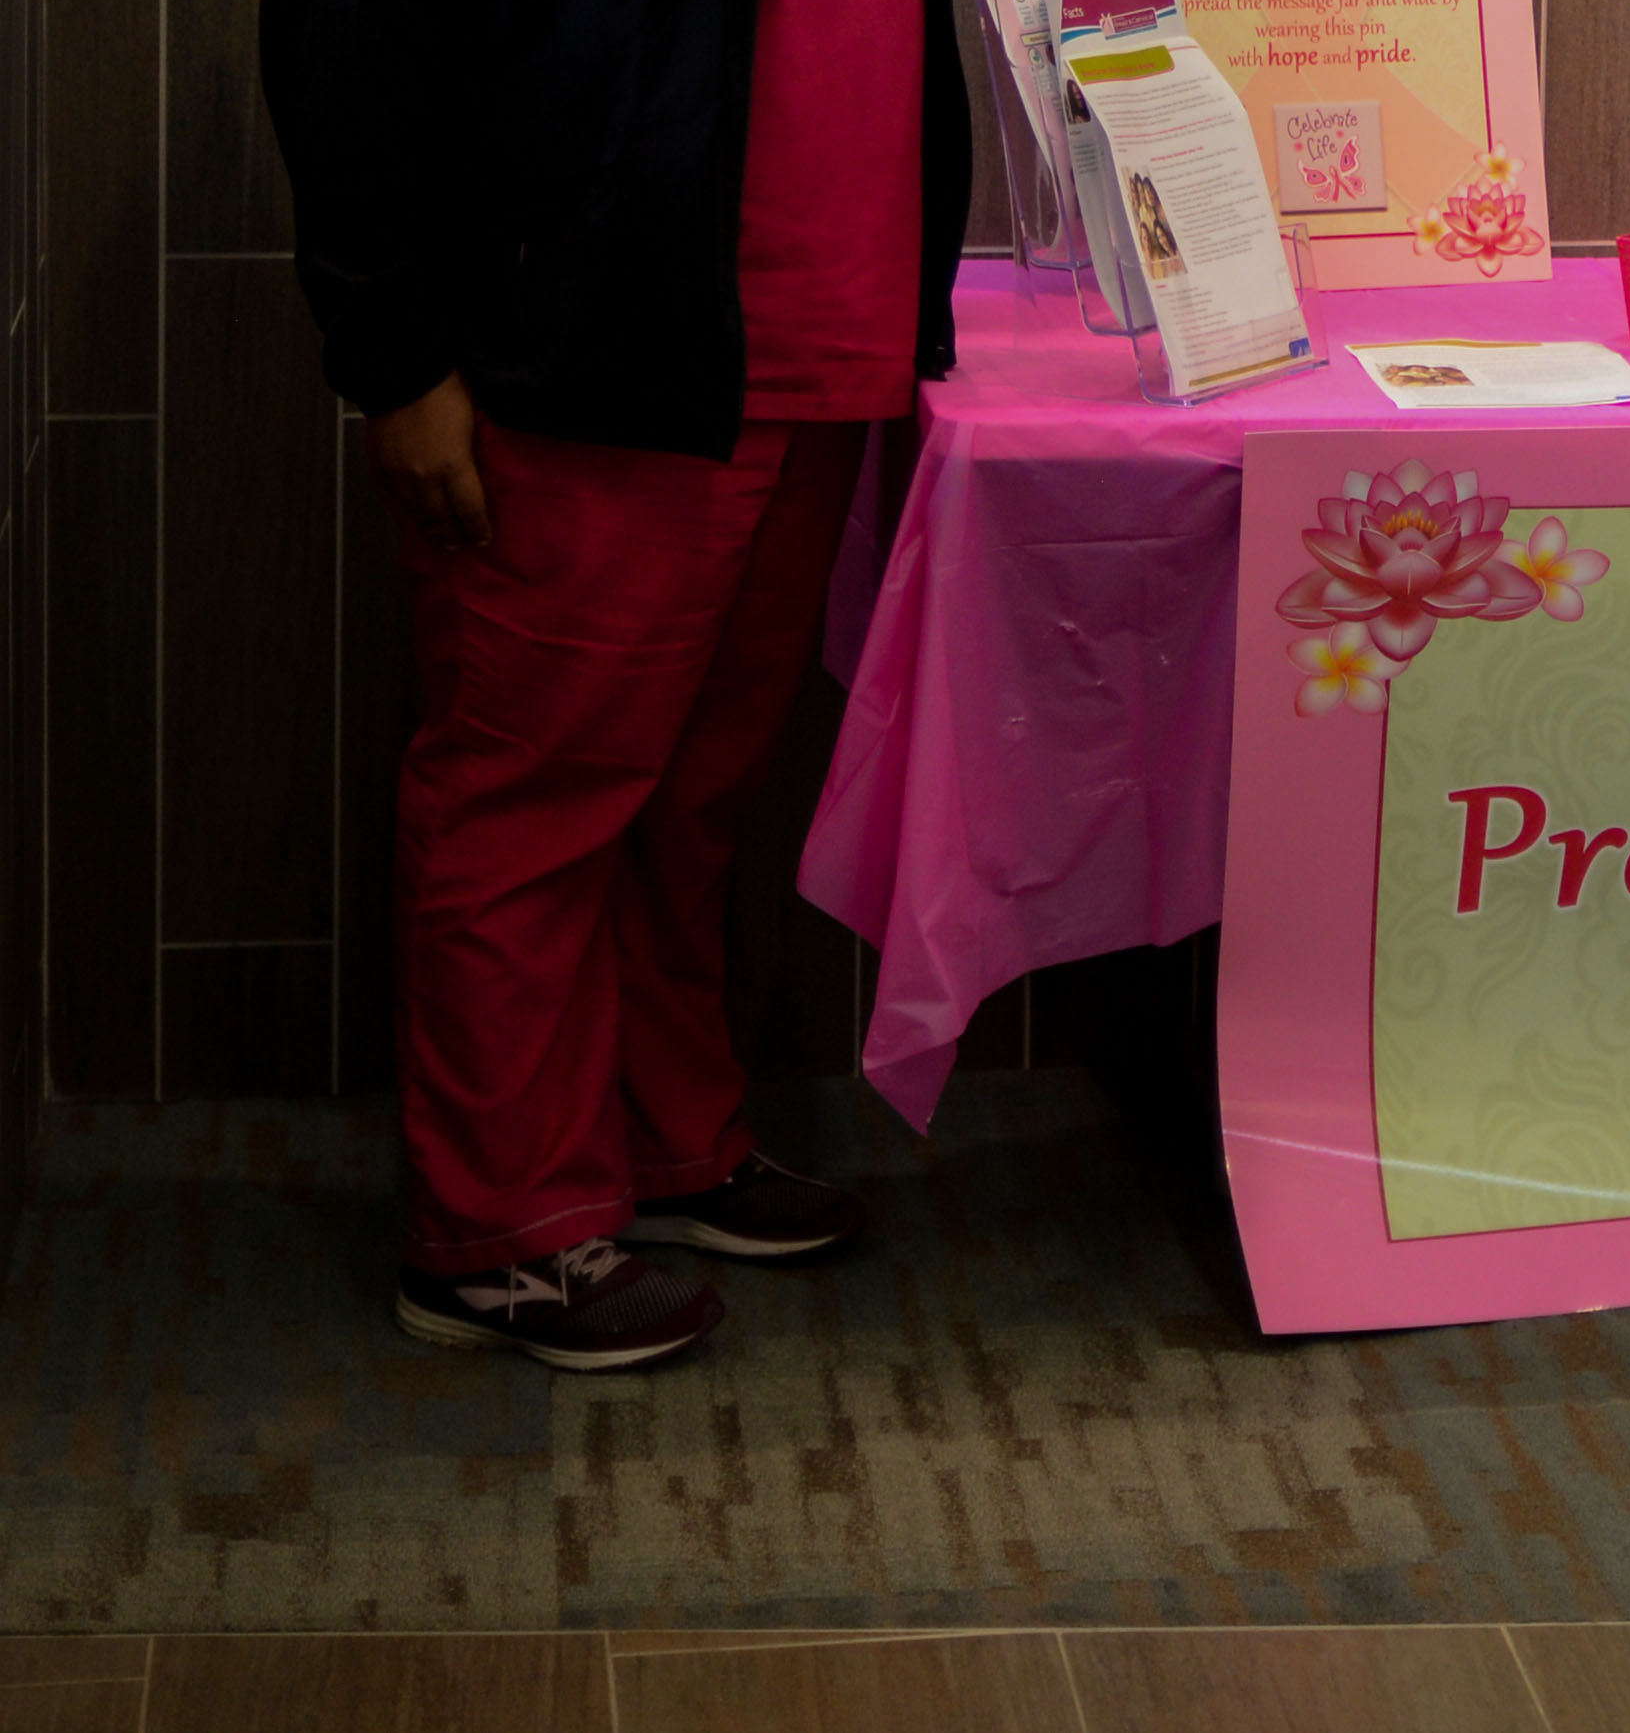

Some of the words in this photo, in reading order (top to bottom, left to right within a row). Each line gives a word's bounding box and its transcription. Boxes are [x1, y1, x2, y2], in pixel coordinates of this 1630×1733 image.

[1255, 22, 1320, 43] wearing
[1325, 19, 1355, 37] this
[1360, 19, 1386, 42] pin
[1228, 46, 1262, 68] with
[1268, 42, 1318, 73] hope
[1323, 45, 1351, 65] and
[1355, 38, 1416, 71] pride.
[1287, 109, 1358, 139] Celebrate
[1307, 135, 1337, 161] Life
